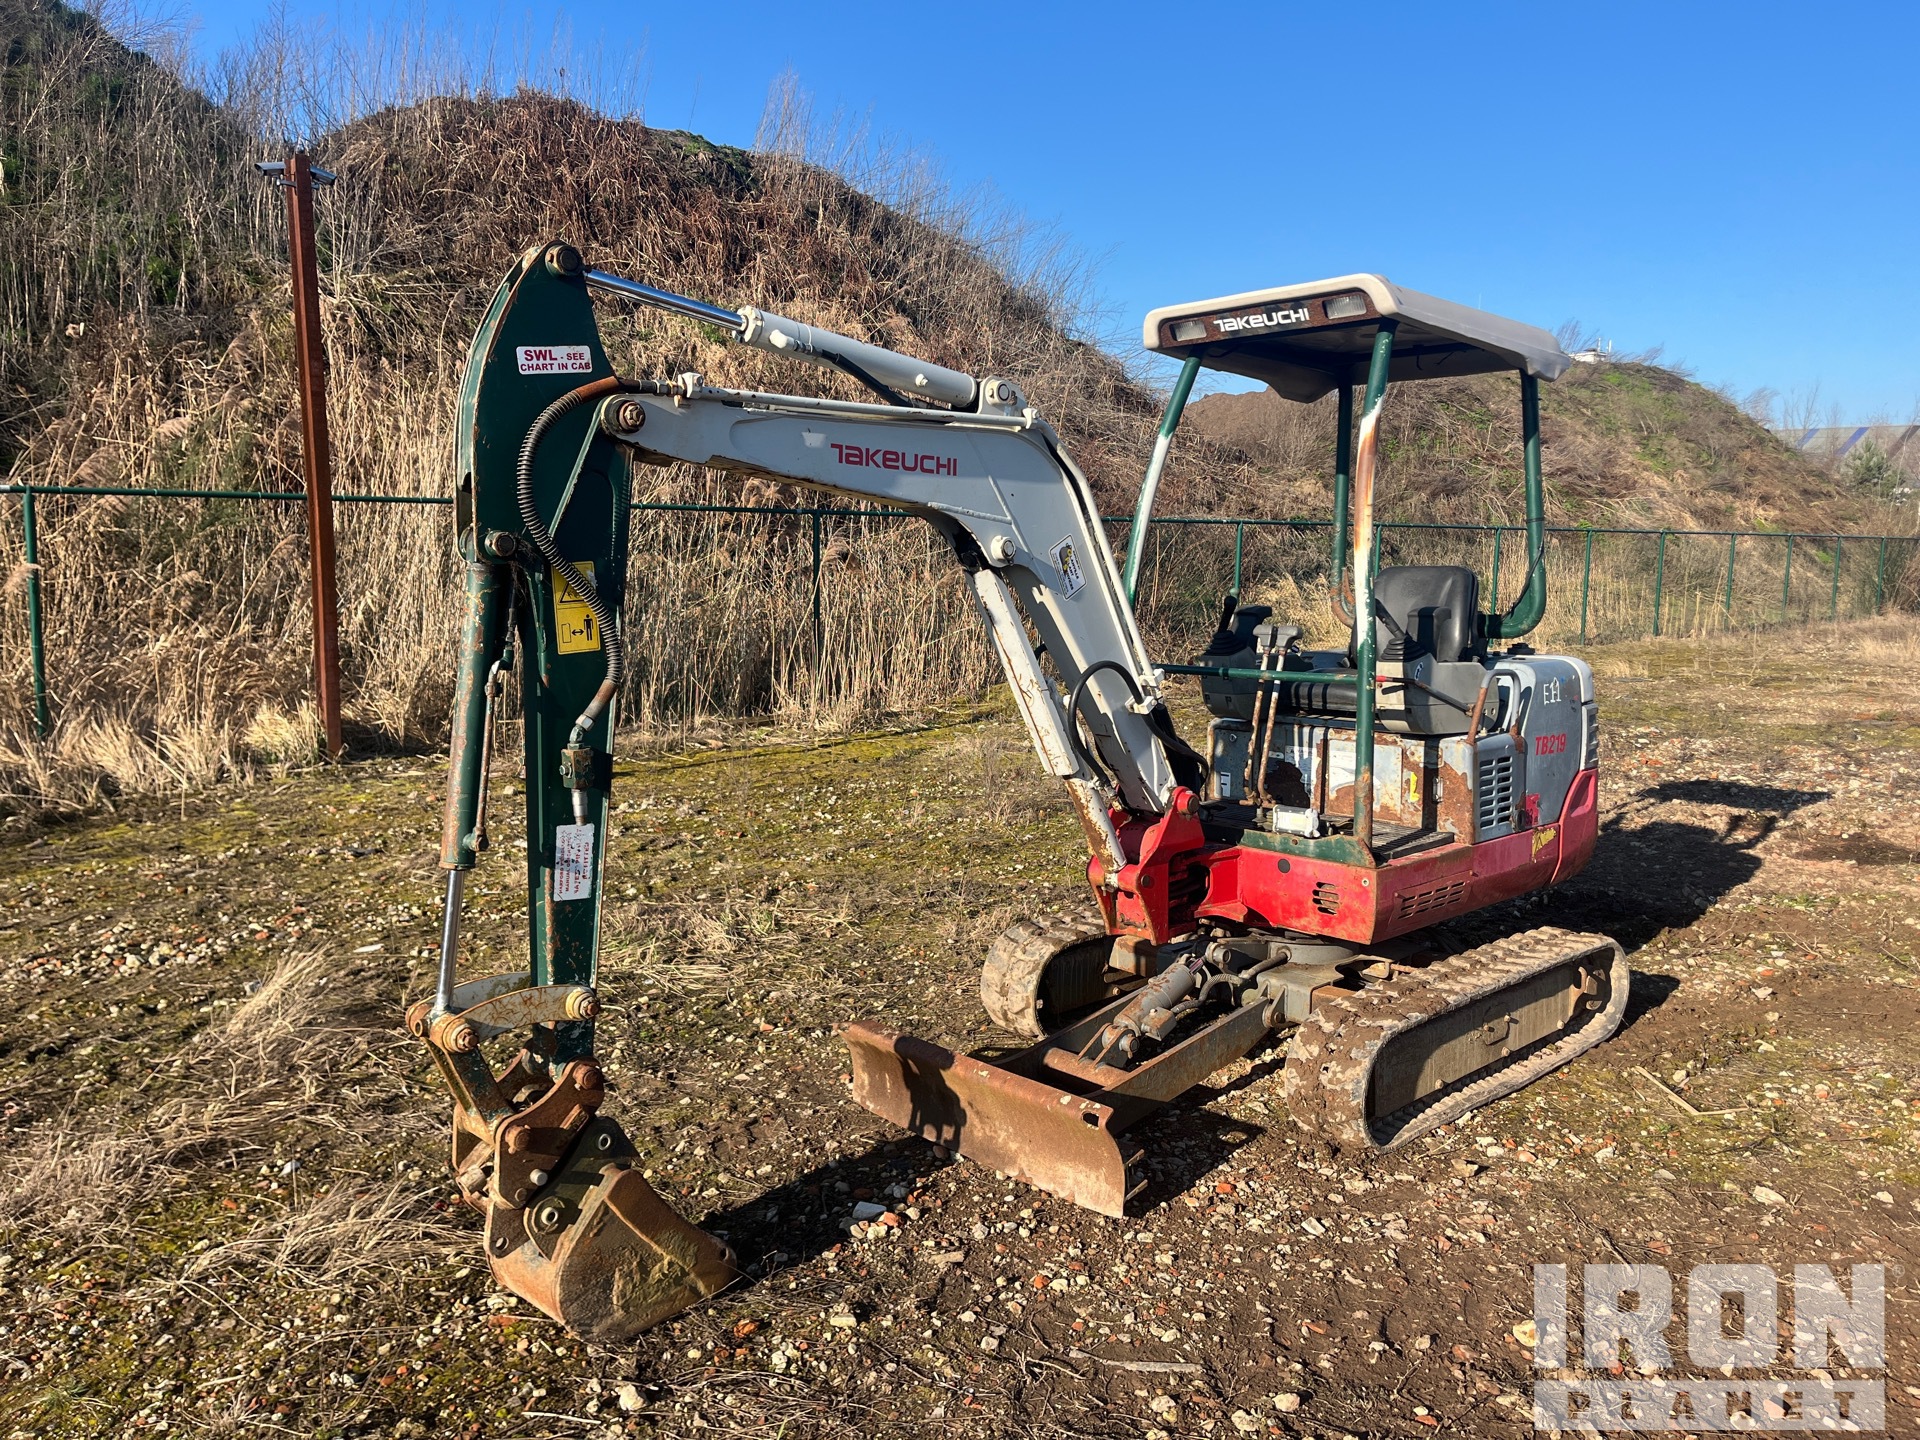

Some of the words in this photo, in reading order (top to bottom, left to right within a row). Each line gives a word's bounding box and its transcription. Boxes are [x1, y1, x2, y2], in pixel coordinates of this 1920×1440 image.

[1213, 308, 1310, 332] TAKEUCHI
[520, 363, 554, 372] CHART
[558, 362, 568, 370] IN
[571, 362, 592, 370] CAB
[524, 349, 558, 362] SWL
[566, 352, 585, 360] SEE
[830, 443, 958, 476] TAKEUCHI
[1535, 733, 1567, 756] TB219
